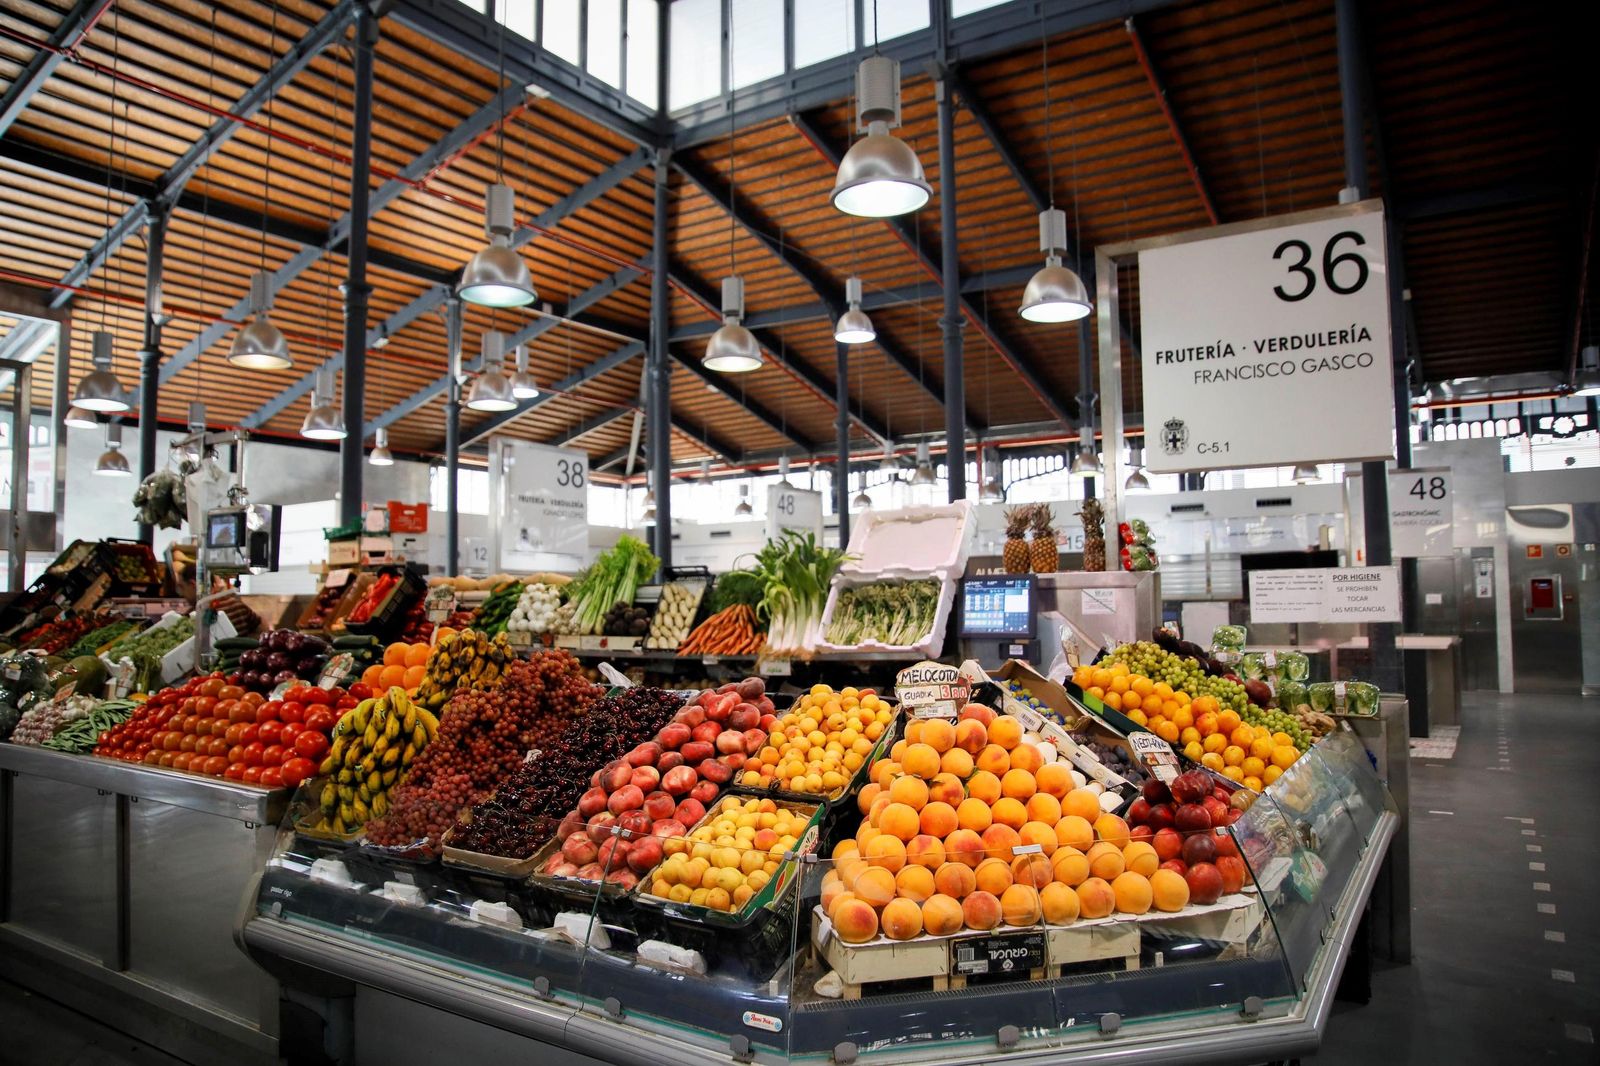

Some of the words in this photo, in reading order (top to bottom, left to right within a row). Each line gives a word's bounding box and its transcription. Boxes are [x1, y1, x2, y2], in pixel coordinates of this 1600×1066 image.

[1272, 231, 1370, 302] 36
[1156, 340, 1236, 365] FRUTERÍA
[1254, 323, 1373, 355] VERDULERÍA
[1194, 360, 1296, 385] FRANCISCO
[1301, 352, 1374, 375] GASCO
[1197, 441, 1230, 455] C-5.1
[557, 459, 584, 488] 38
[1409, 476, 1446, 500] 48
[777, 493, 795, 516] 48
[474, 547, 487, 560] 12
[1067, 535, 1084, 550] 15
[1332, 574, 1348, 582] POR
[1350, 573, 1381, 581] HIGIENE
[988, 947, 1028, 960] GRUCAL
